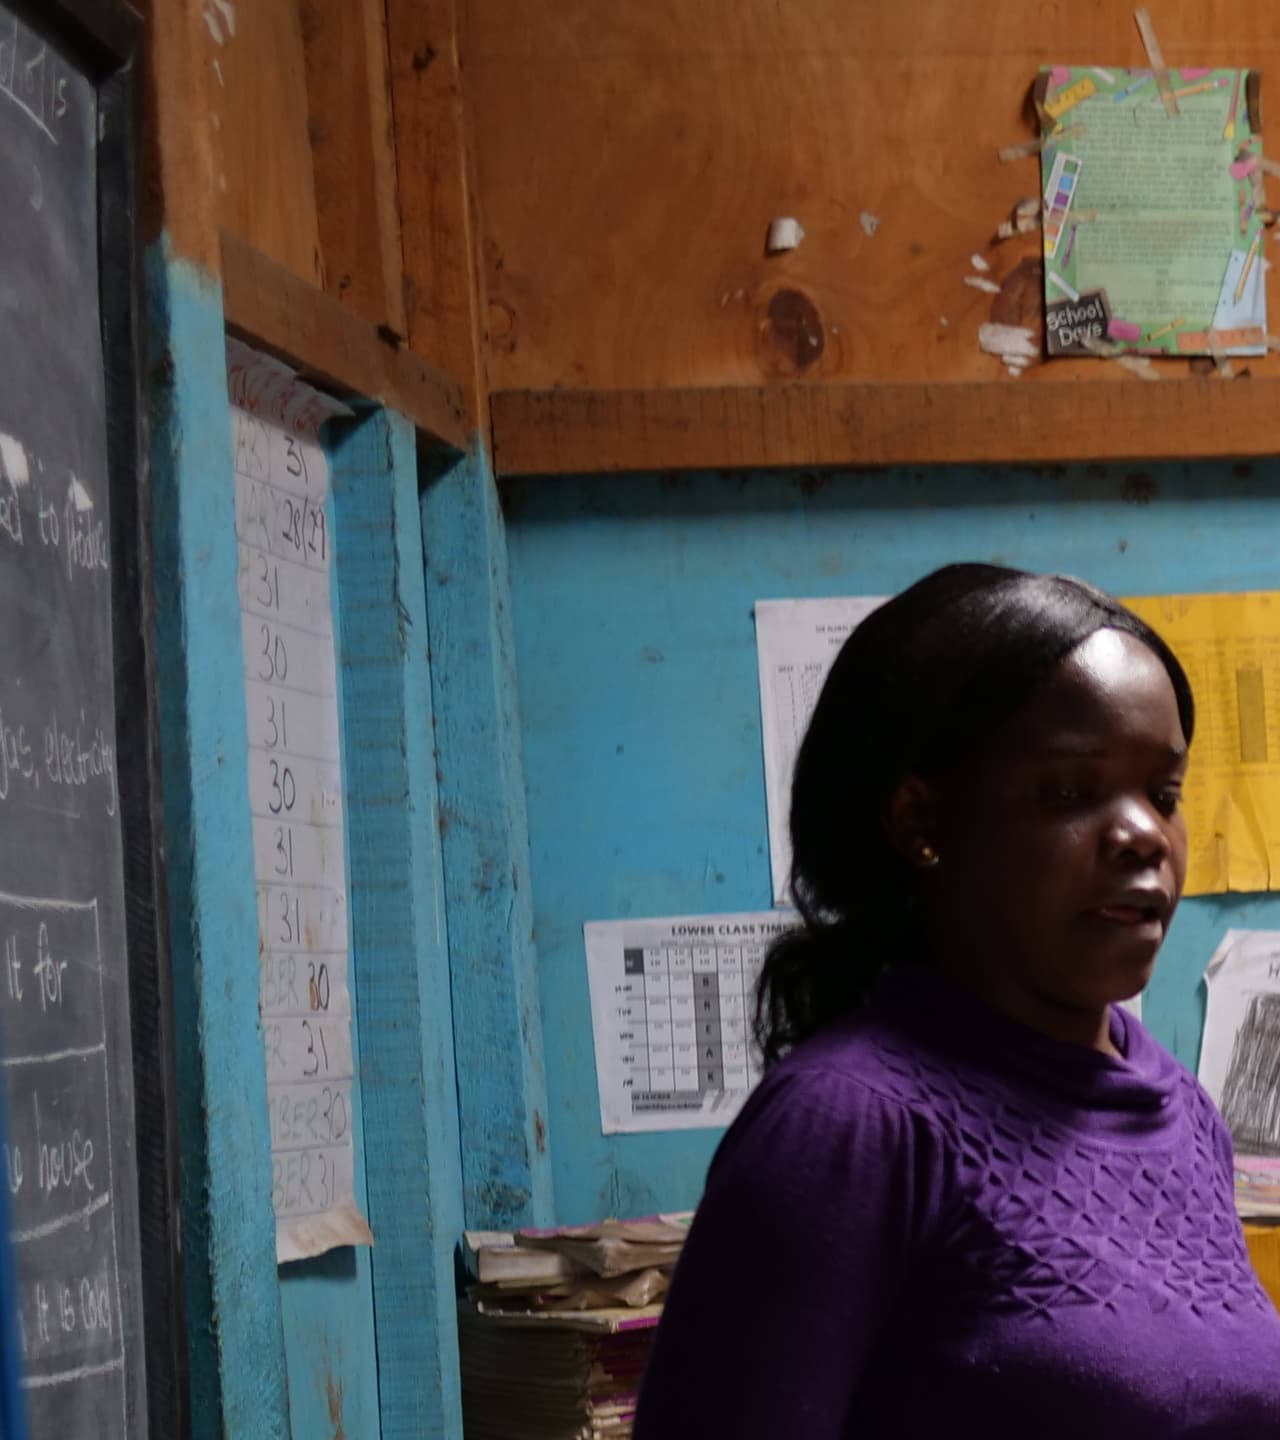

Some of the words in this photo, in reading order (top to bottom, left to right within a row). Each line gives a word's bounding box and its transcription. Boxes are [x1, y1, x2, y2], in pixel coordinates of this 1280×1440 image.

[256, 553, 280, 613] 31
[259, 624, 288, 684] 30
[263, 696, 288, 750] 31
[267, 758, 297, 814] 30
[274, 829, 294, 879] 31
[279, 890, 301, 945] 31
[671, 924, 715, 937] LOWER
[718, 923, 756, 936] CLASS
[303, 1018, 330, 1078] 31
